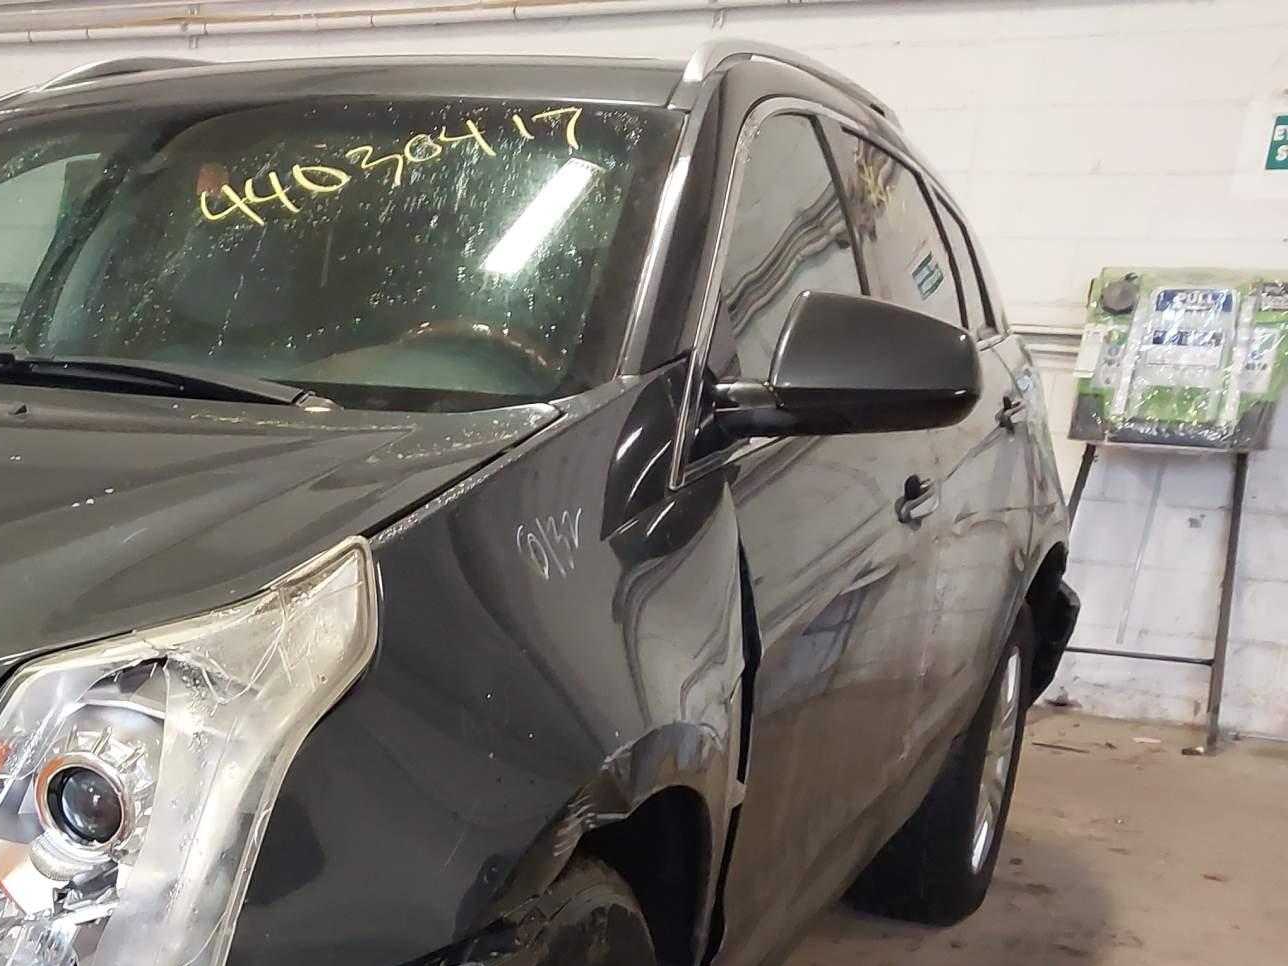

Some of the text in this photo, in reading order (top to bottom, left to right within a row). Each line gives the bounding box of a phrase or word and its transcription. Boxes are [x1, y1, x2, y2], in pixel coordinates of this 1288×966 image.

[1273, 125, 1288, 141] E
[1275, 145, 1288, 161] S
[199, 107, 583, 226] 44030417
